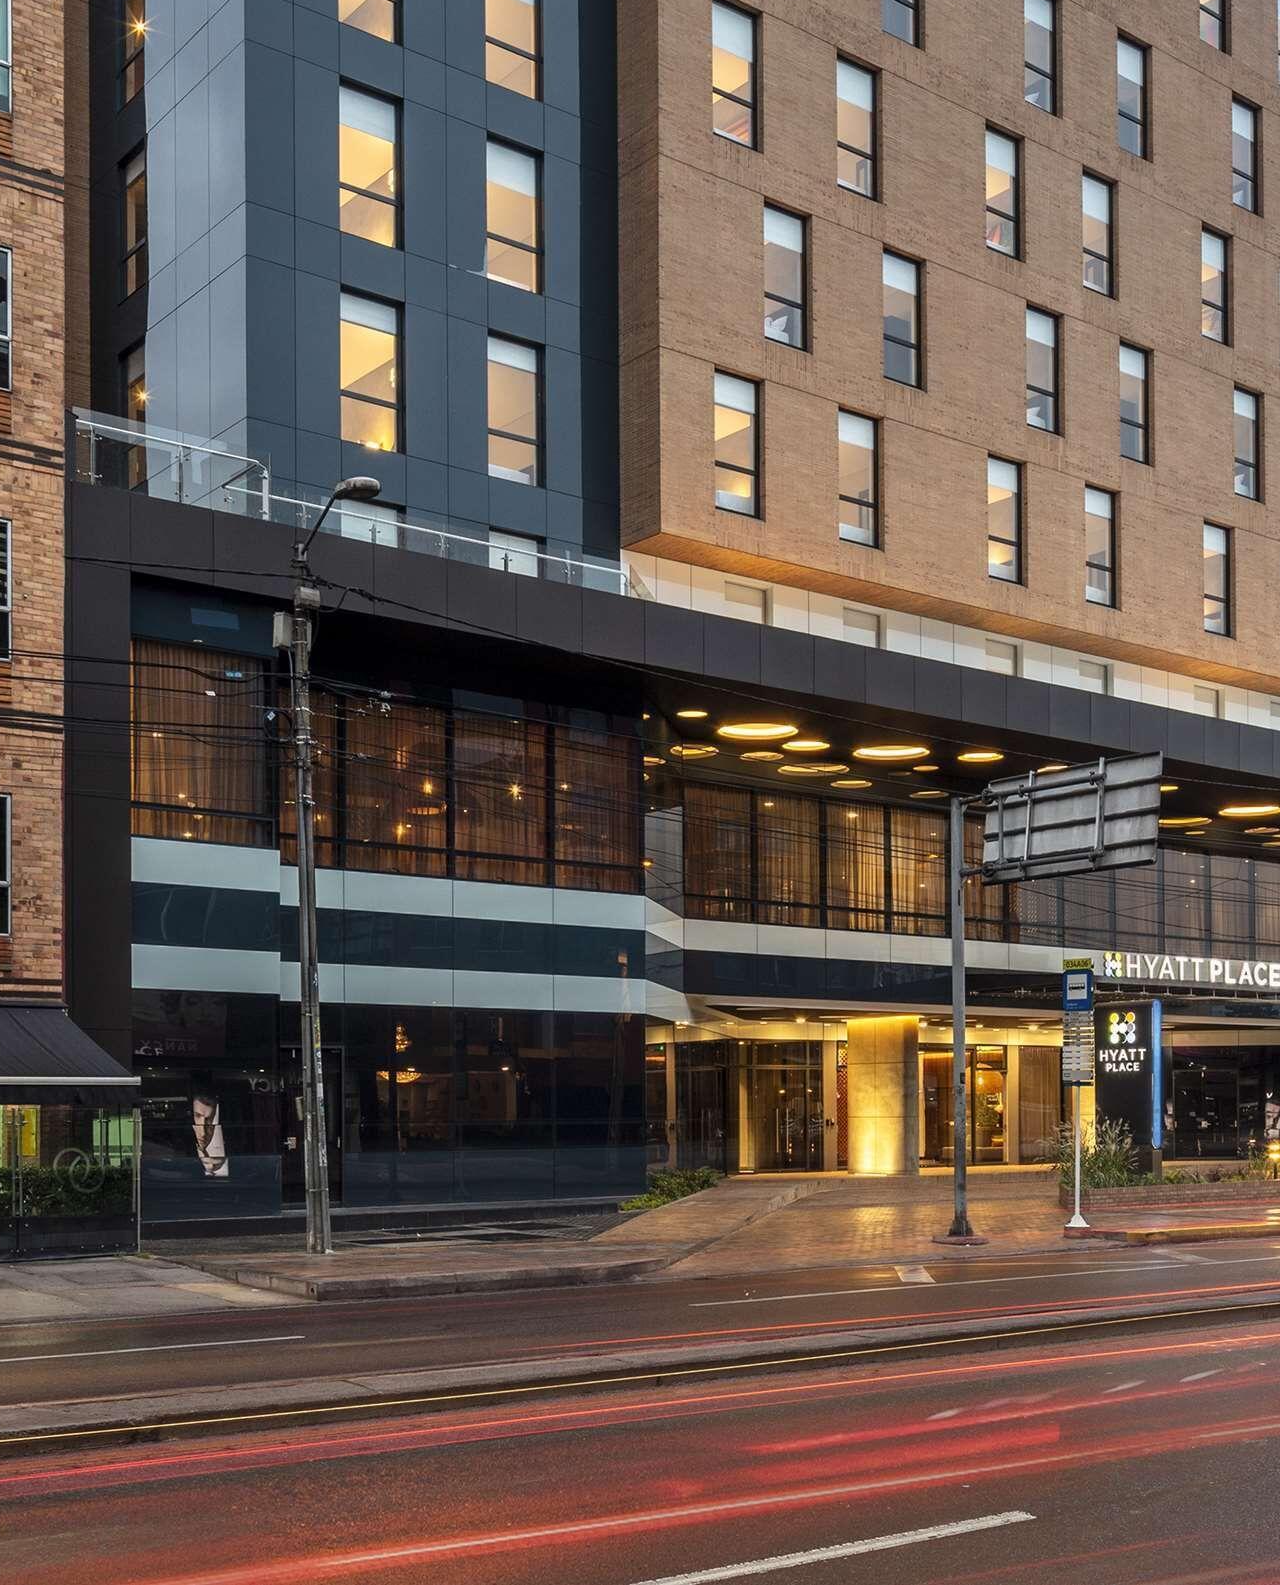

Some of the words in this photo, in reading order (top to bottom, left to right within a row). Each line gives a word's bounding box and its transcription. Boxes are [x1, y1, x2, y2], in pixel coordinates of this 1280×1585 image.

[1126, 954, 1204, 982] HYATT
[1210, 959, 1280, 987] PLACE
[1099, 1048, 1147, 1062] HYATT
[1105, 1062, 1140, 1073] PLACE
